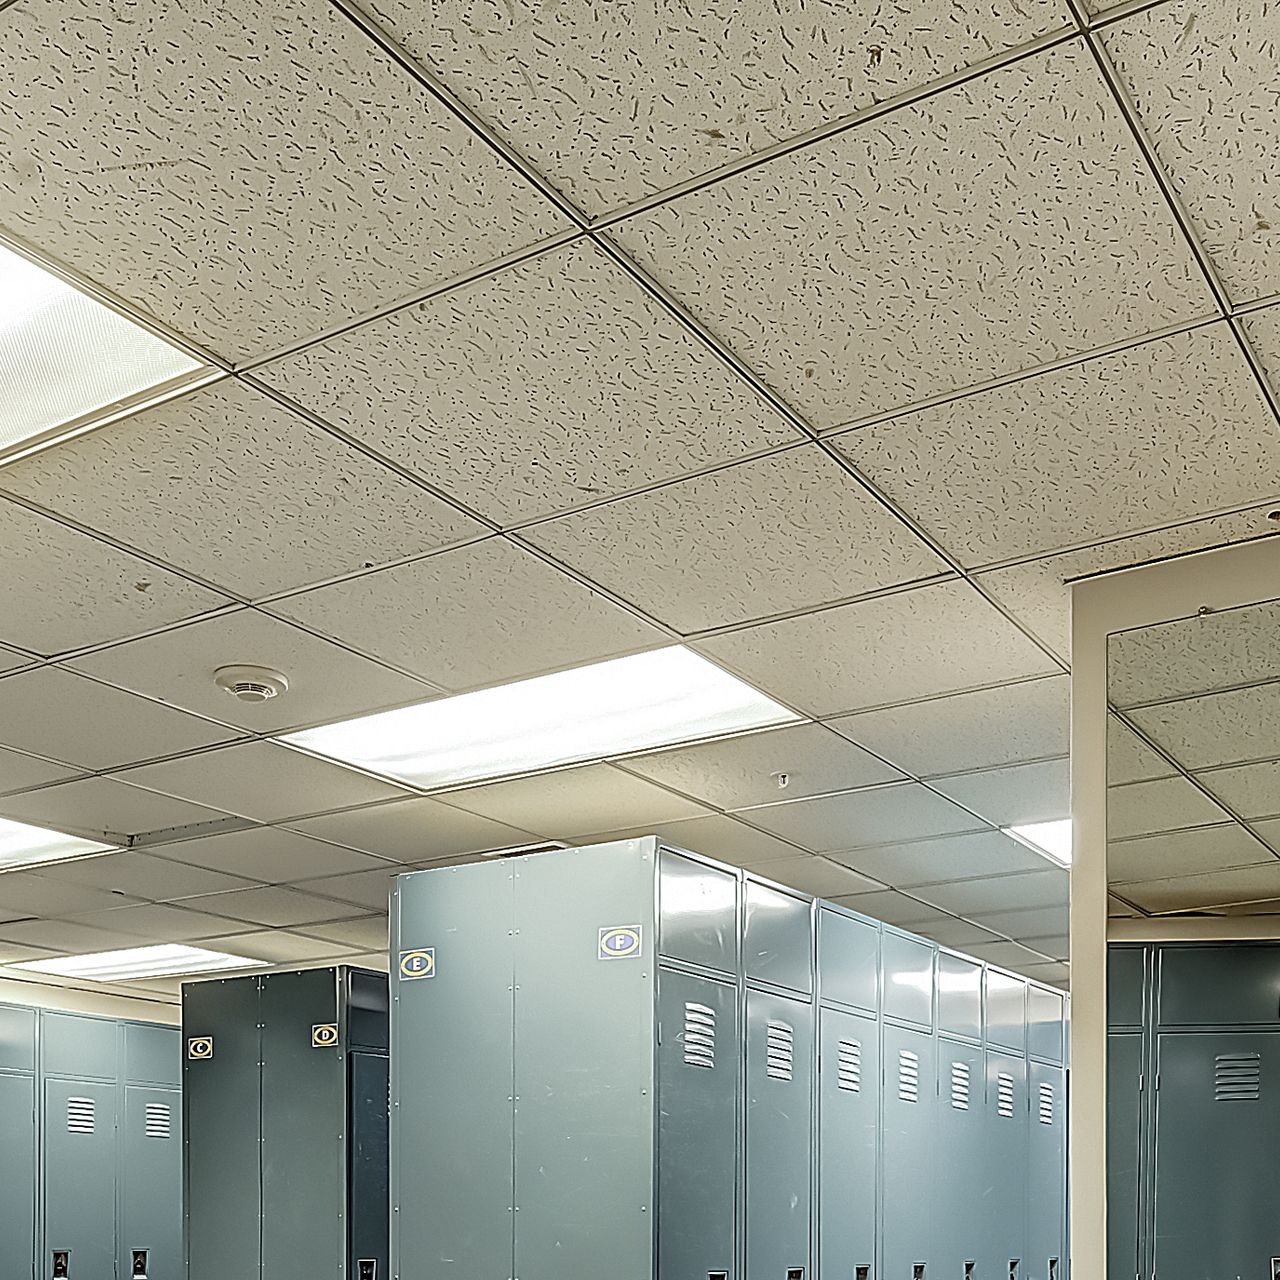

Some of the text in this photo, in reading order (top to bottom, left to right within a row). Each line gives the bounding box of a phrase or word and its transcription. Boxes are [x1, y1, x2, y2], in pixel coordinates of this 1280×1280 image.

[615, 935, 624, 949] F
[413, 958, 421, 970] E
[322, 1030, 329, 1040] D
[197, 1043, 203, 1053] C
